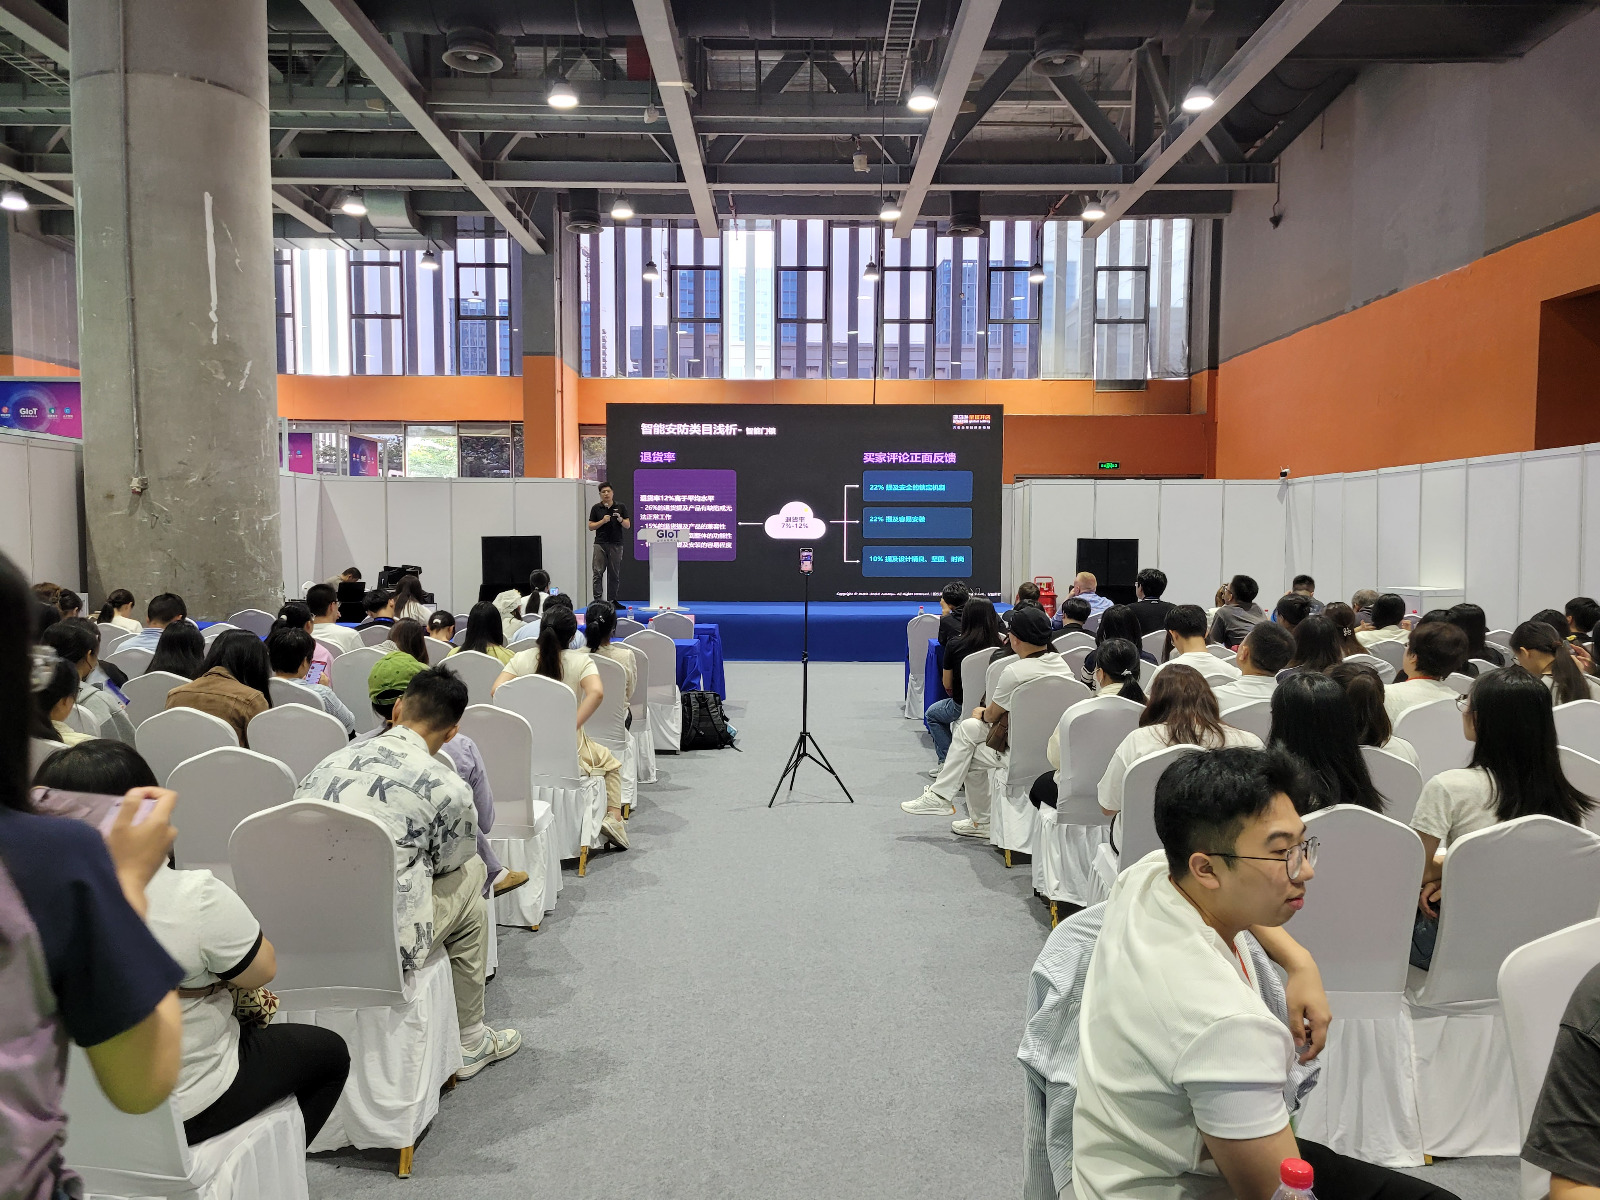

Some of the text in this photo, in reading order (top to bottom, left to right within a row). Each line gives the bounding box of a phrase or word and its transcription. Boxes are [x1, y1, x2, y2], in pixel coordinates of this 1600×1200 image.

[639, 451, 676, 463] 退货率
[863, 452, 957, 464] 买家评论正面反馈
[656, 529, 681, 539] GIoT
[323, 775, 355, 803] K
